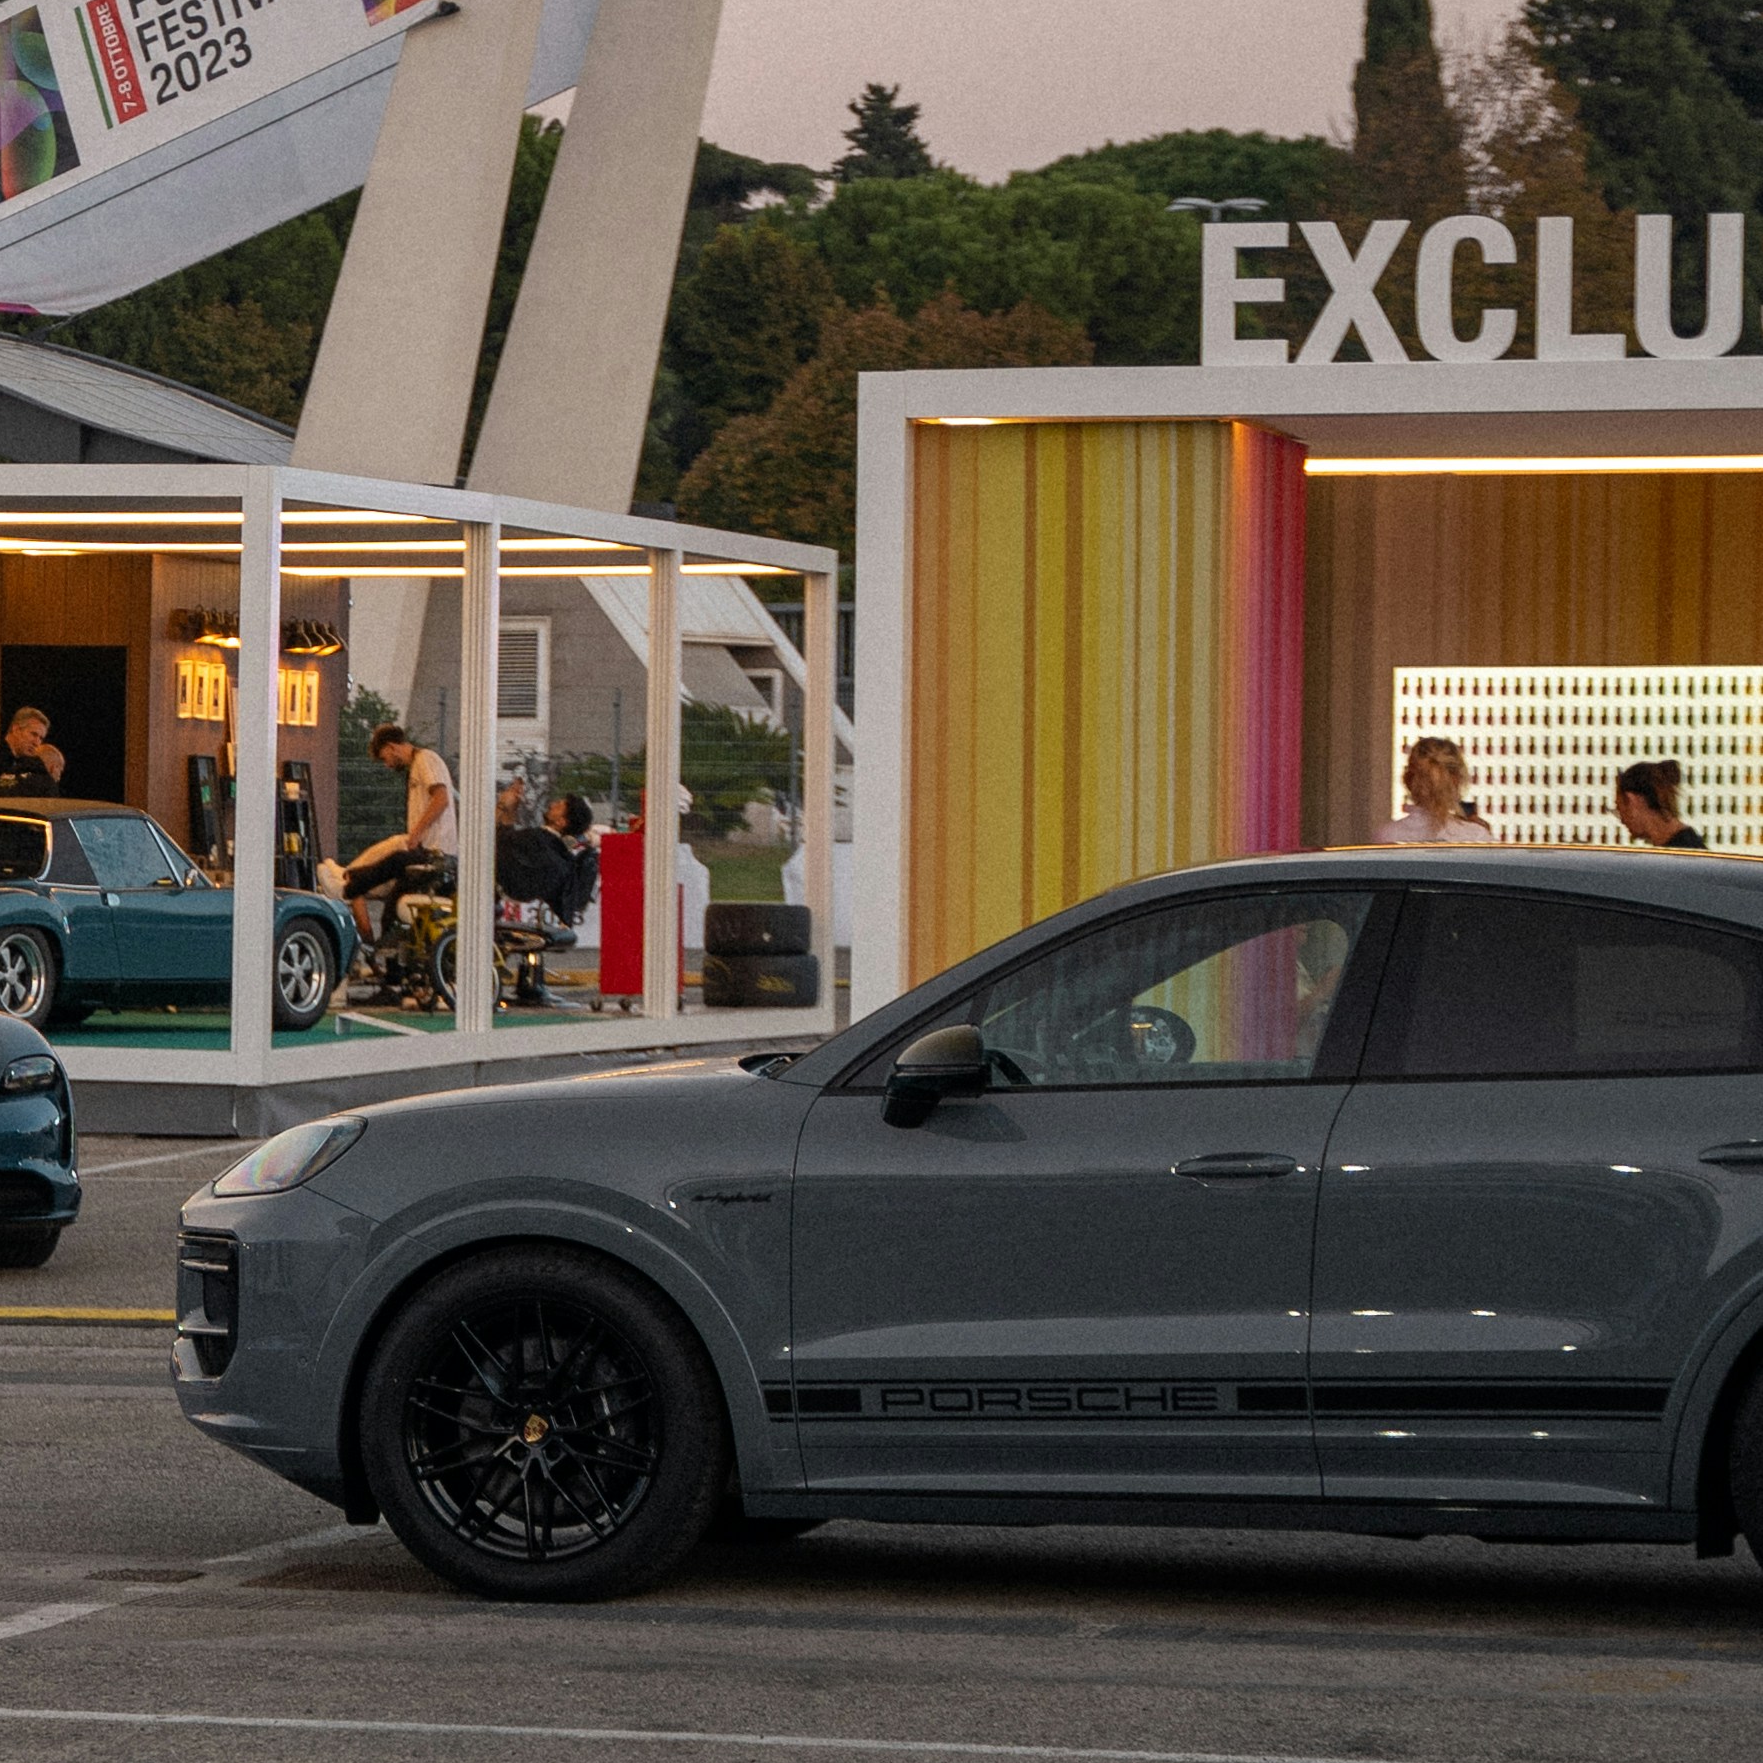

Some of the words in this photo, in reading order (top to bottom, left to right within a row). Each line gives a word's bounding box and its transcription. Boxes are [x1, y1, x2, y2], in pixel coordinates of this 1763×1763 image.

[96, 1, 129, 81] OTTOBRE
[150, 27, 252, 106] 2023
[118, 80, 138, 113] 7-8
[1201, 212, 1763, 366] EXCLU
[880, 1385, 1219, 1413] PORSCHE
